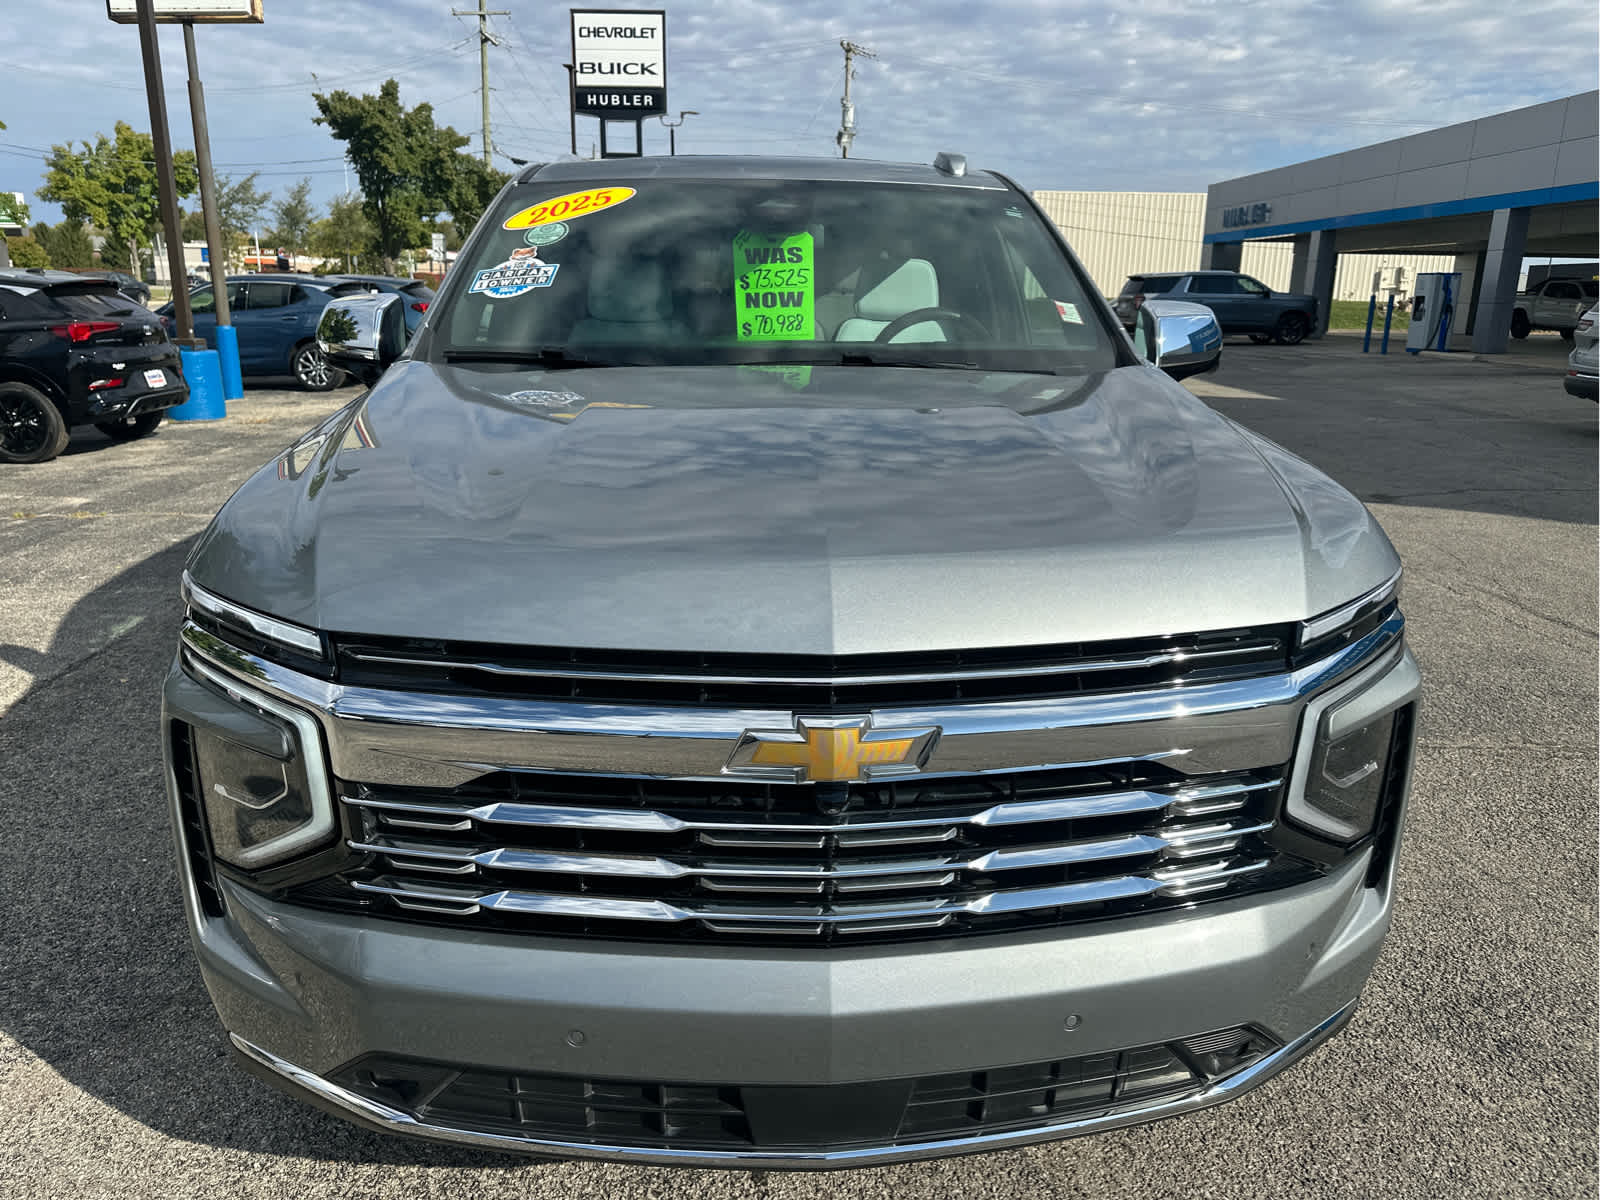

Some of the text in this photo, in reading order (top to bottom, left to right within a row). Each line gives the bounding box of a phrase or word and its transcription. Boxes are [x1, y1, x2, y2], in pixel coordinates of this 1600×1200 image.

[578, 26, 657, 39] CHEVROLET
[579, 62, 658, 76] BUICK
[587, 94, 654, 106] HUBLER
[527, 190, 613, 225] 2025
[744, 246, 803, 265] WAS
[481, 267, 552, 280] CARFAX
[488, 276, 548, 288] OWNER
[745, 291, 805, 309] NOW
